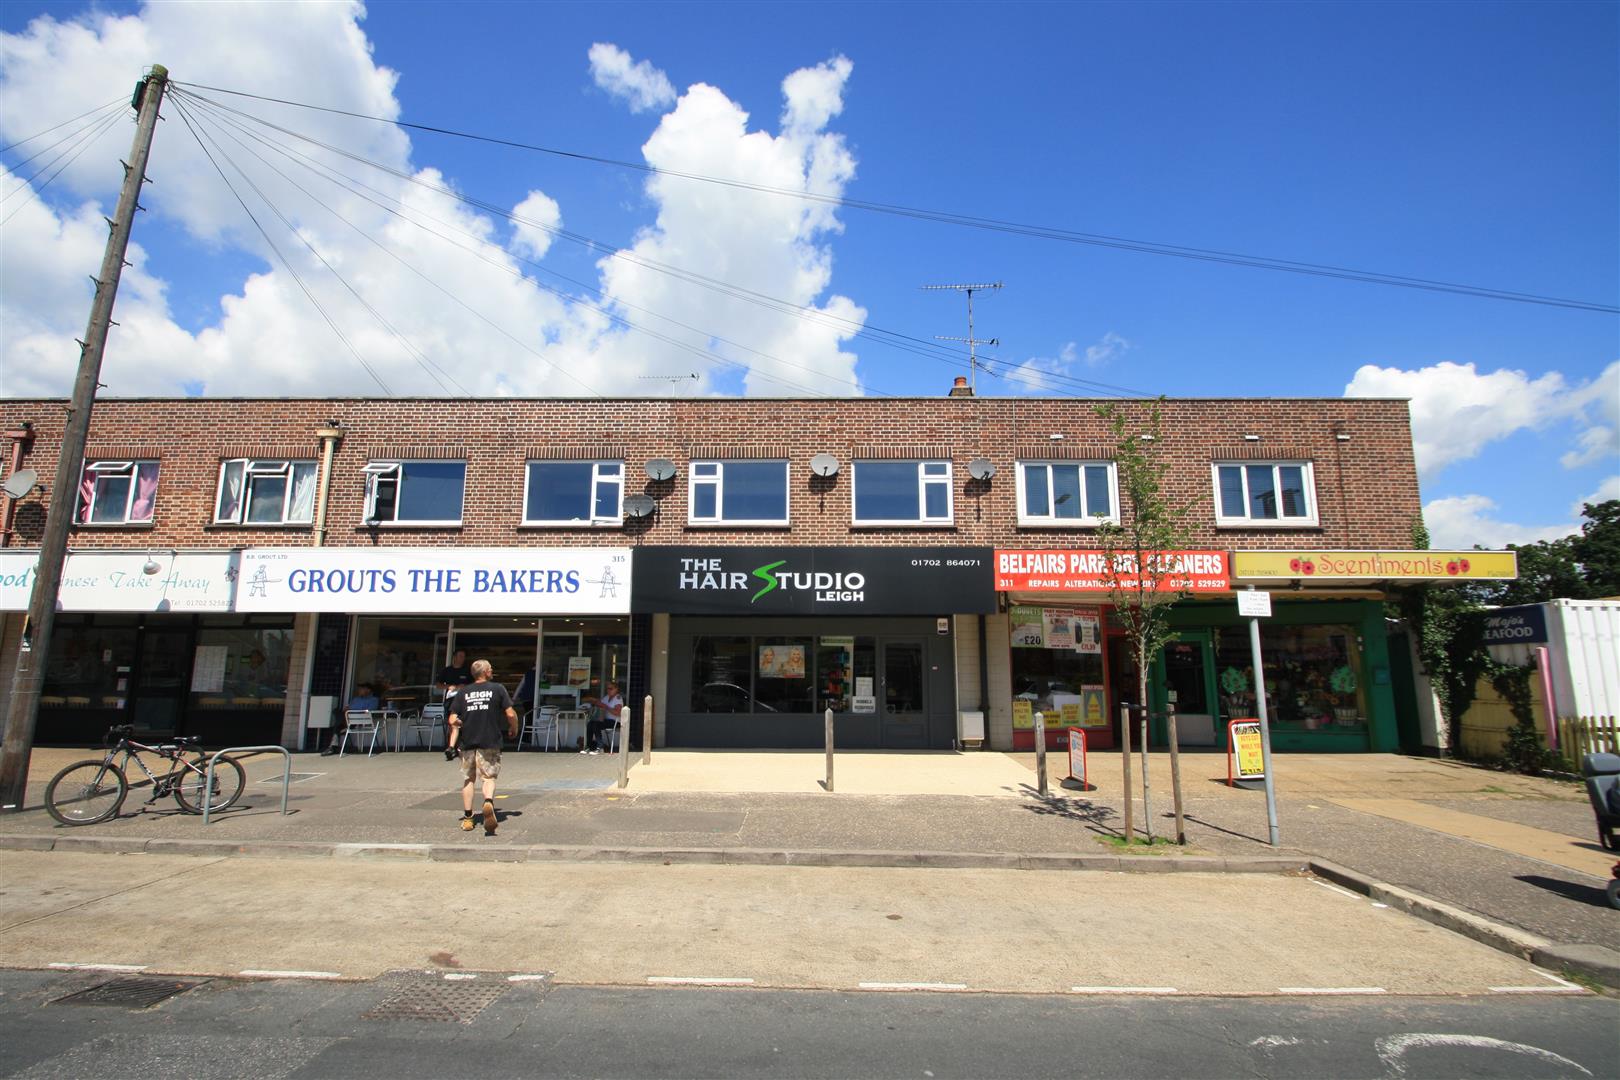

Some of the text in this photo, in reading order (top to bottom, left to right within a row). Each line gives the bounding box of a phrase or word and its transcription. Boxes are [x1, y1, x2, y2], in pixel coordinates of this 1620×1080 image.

[612, 555, 626, 563] 315
[680, 558, 722, 572] THE
[911, 559, 981, 567] 01702 864071
[999, 554, 1067, 575] BELFAIRS
[1070, 554, 1109, 574] PARK
[1318, 554, 1443, 576] Scentiments
[109, 571, 152, 588] Take
[159, 571, 211, 593] Away
[288, 569, 580, 594] GROUTS THE BAKERS
[679, 560, 865, 603] HAIR STUDIO
[1000, 579, 1014, 587] 311
[1028, 579, 1060, 588] REPAIRS
[1197, 579, 1226, 588] 529529
[815, 591, 864, 602] LEIGH
[1024, 635, 1041, 645] £20
[1483, 626, 1534, 640] EAFOOD
[465, 690, 493, 701] LEIGH
